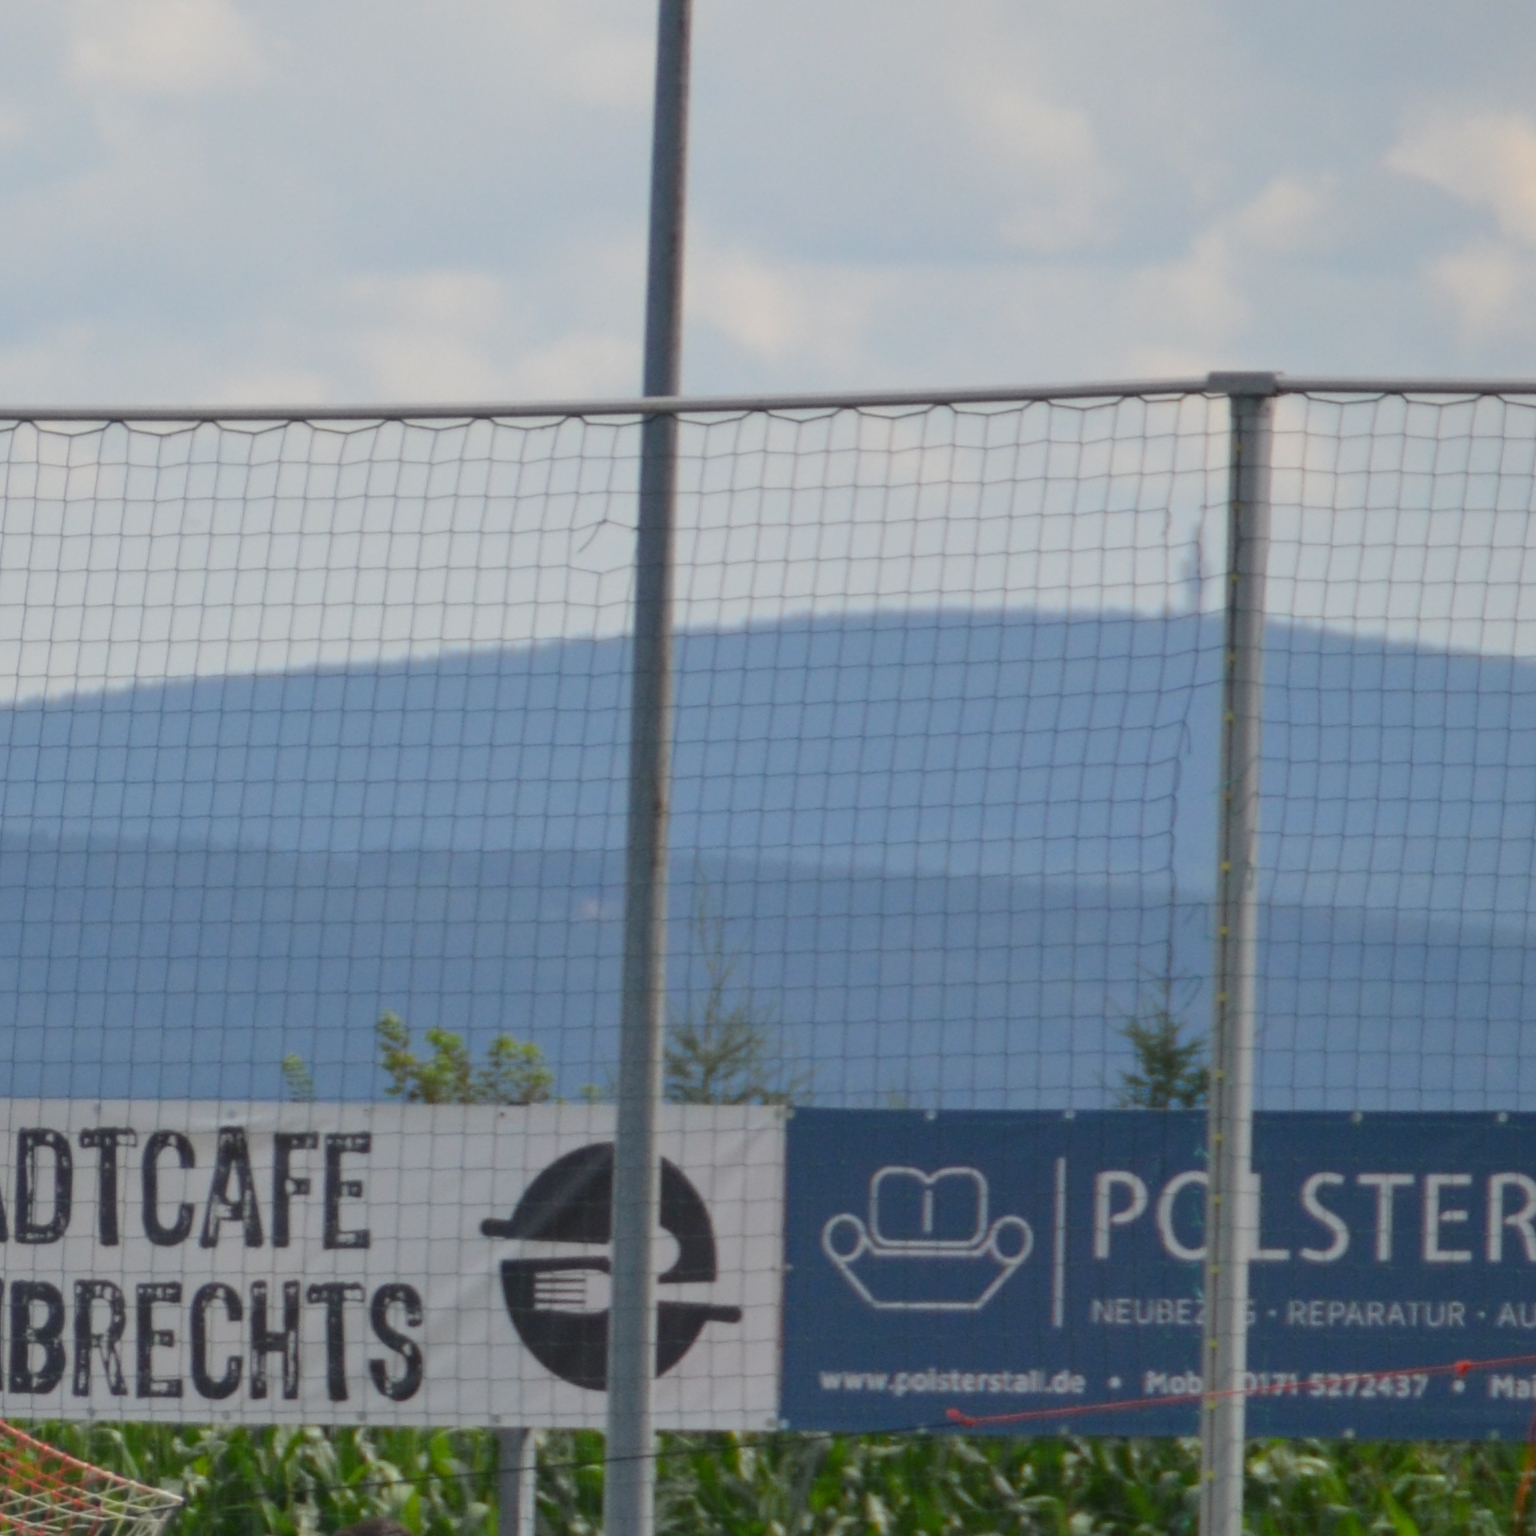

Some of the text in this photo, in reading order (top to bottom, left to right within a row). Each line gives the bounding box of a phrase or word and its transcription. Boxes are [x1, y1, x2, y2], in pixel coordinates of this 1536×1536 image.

[1094, 1170, 1536, 1262] POLSTER
[1090, 1298, 1256, 1326] NEUBEZG
[1288, 1301, 1466, 1328] REPARATUR
[819, 1368, 1086, 1397] www.polsterstall.de
[1310, 1372, 1428, 1398] 5272437
